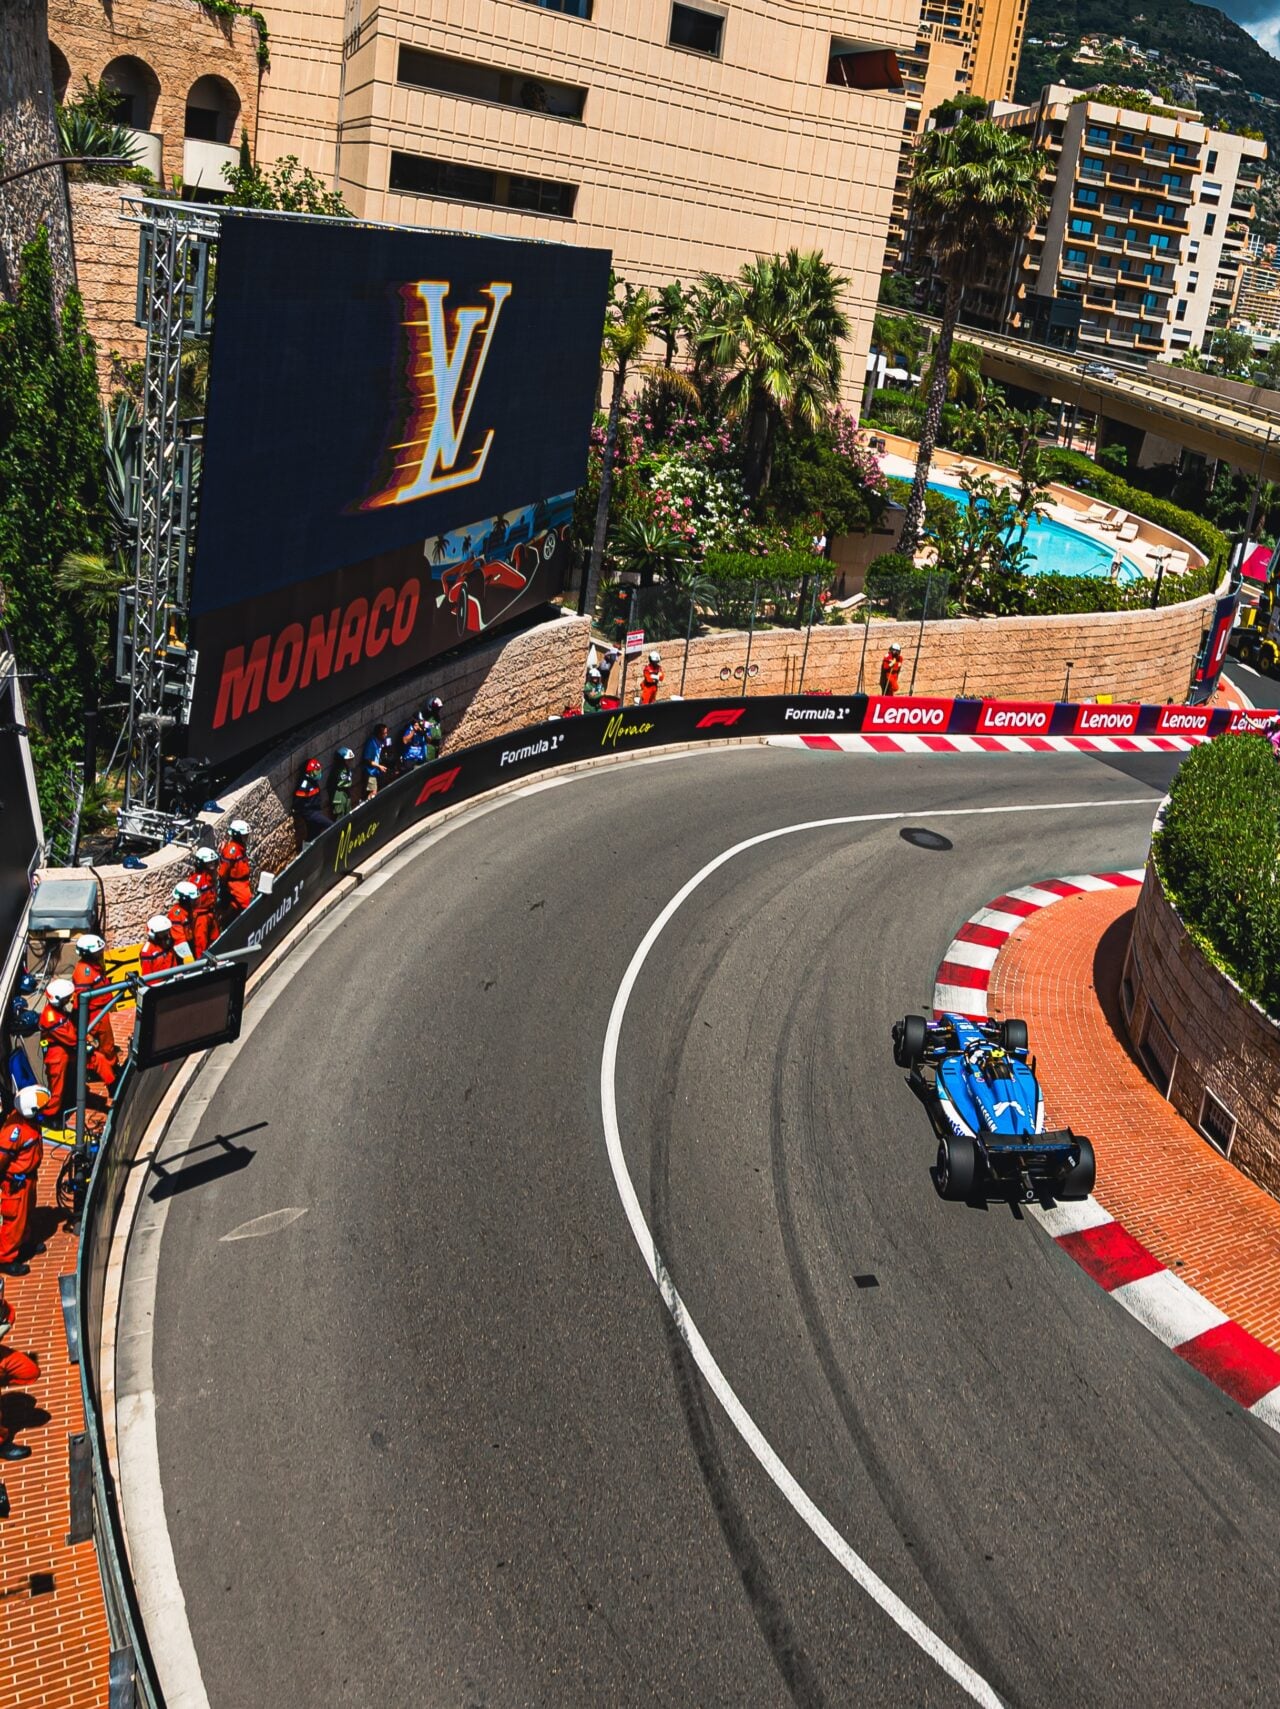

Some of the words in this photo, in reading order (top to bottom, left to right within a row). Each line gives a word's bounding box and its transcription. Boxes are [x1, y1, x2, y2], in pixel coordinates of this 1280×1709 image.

[212, 578, 420, 729] MONACO
[785, 708, 836, 720] Formula
[872, 703, 944, 725] Lenovo
[984, 707, 1046, 728] Lenovo
[1080, 710, 1133, 728] Lenovo
[1162, 711, 1207, 728] Lenovo
[601, 713, 654, 747] Monaco
[500, 740, 549, 767] Formula
[334, 822, 379, 873] Monaco
[247, 896, 292, 947] Formula
